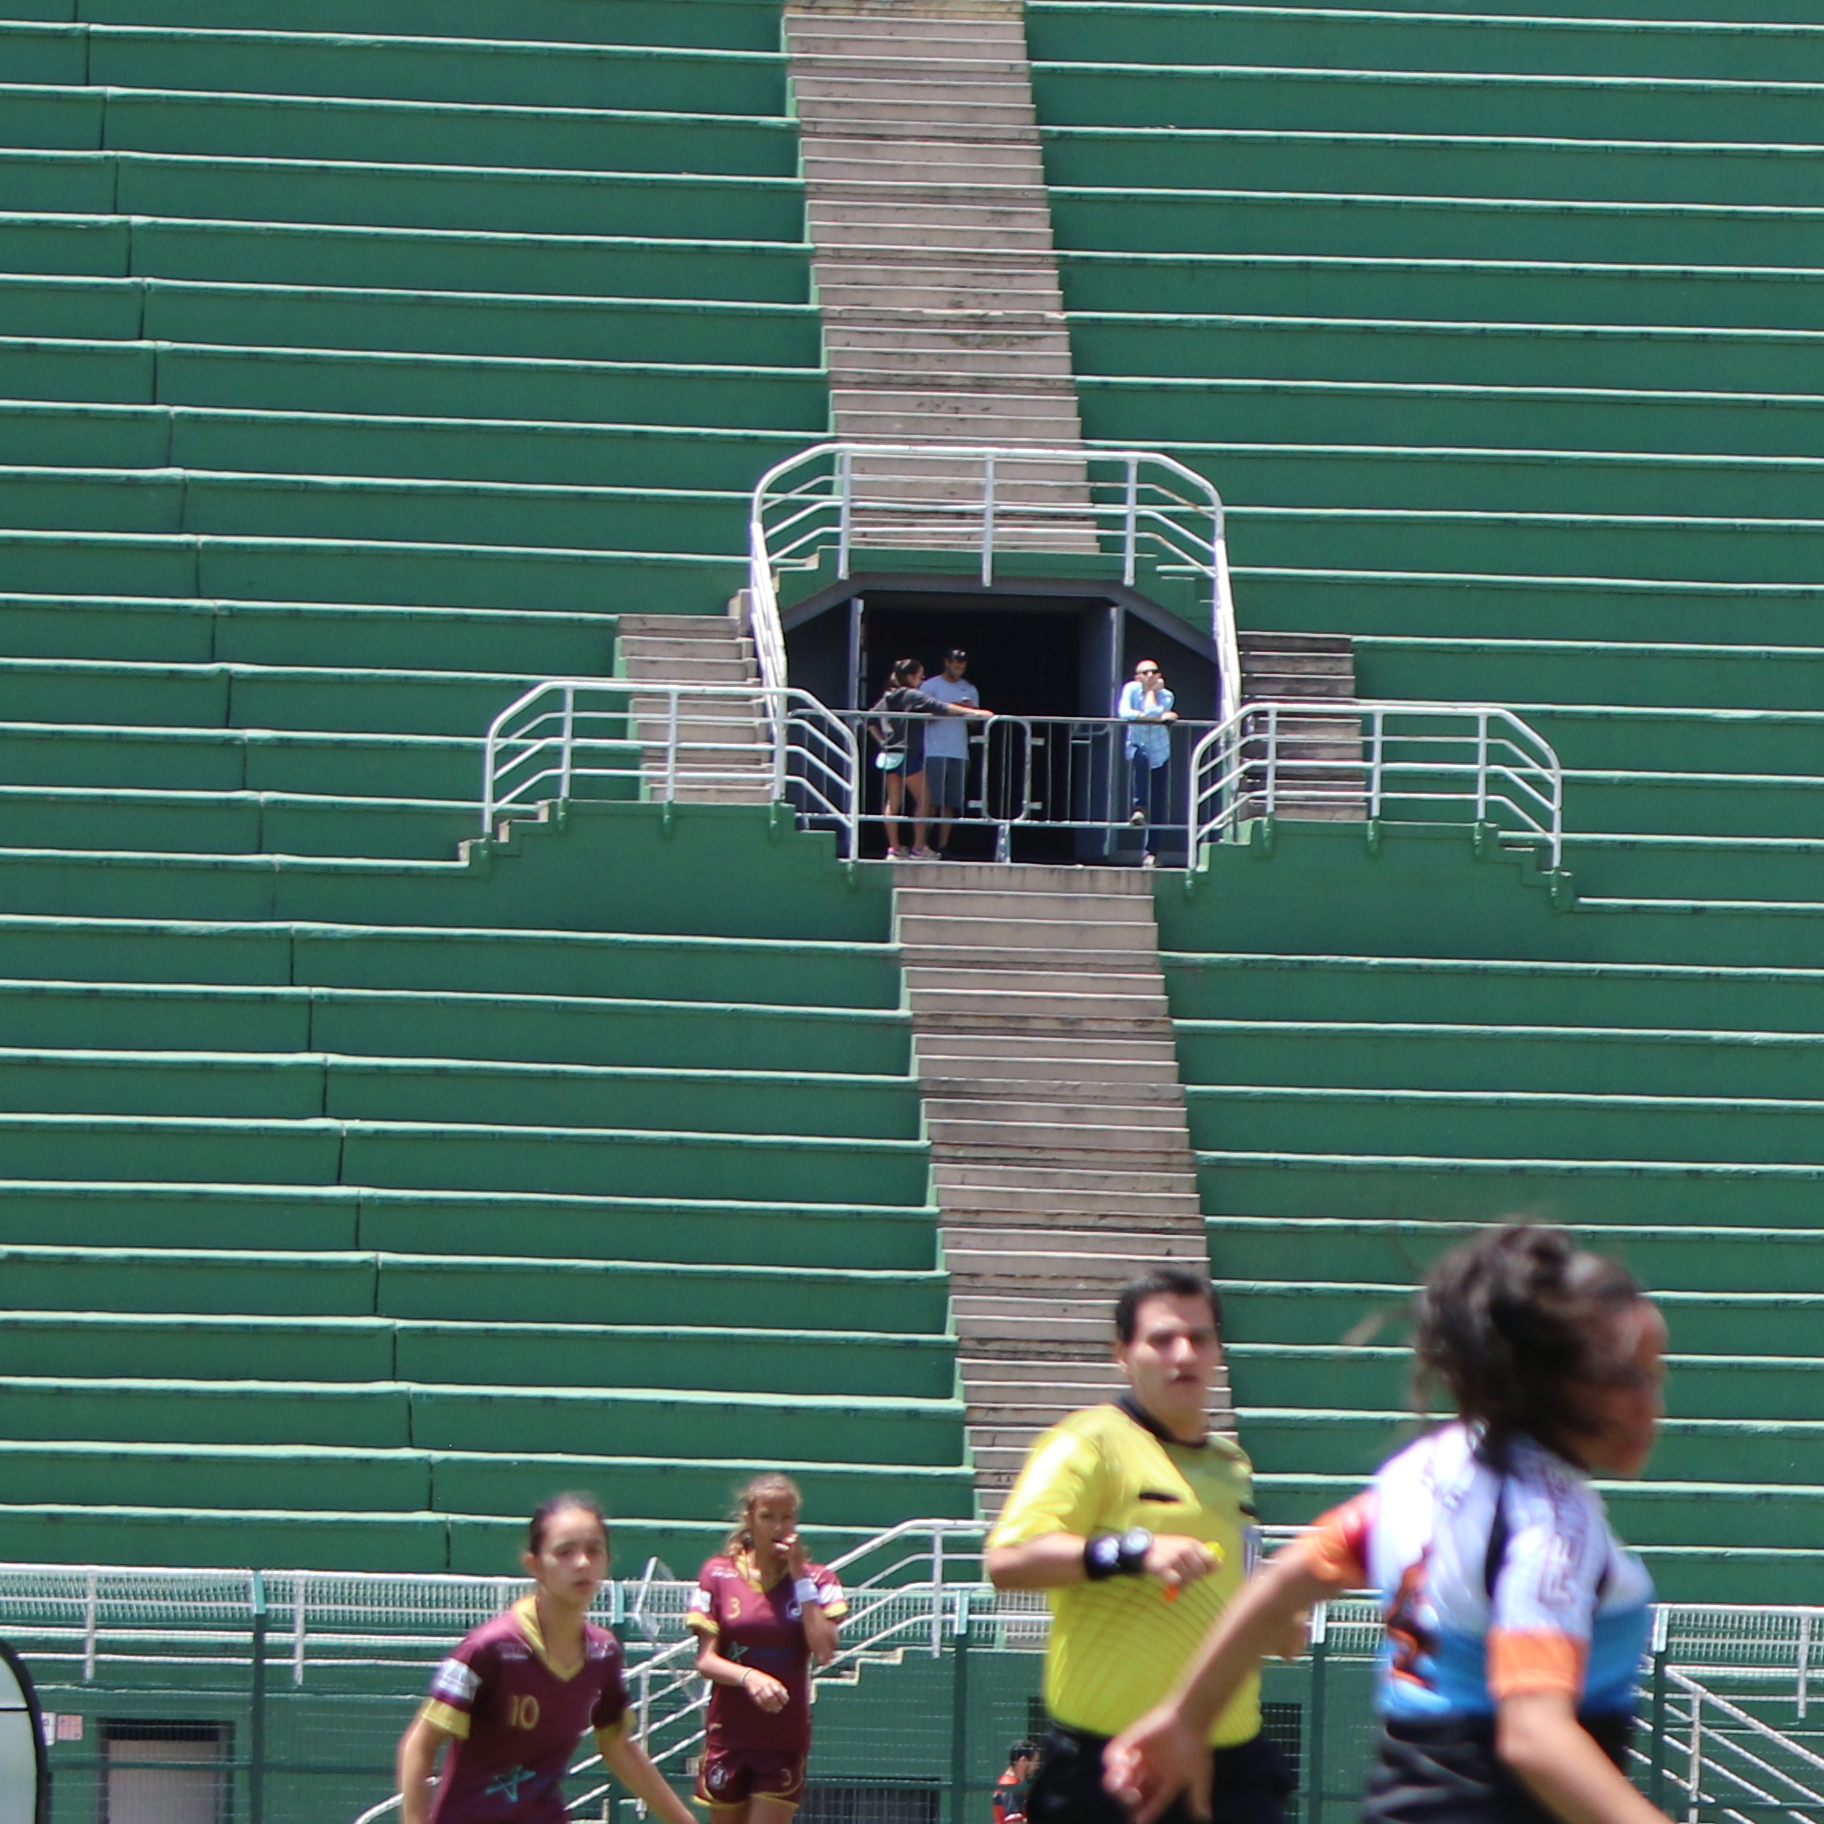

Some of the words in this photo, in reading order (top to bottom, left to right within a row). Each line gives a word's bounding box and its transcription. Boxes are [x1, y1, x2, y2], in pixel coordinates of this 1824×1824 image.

[727, 1597, 741, 1619] 3
[510, 1694, 540, 1730] 10
[780, 1768, 792, 1787] 3
